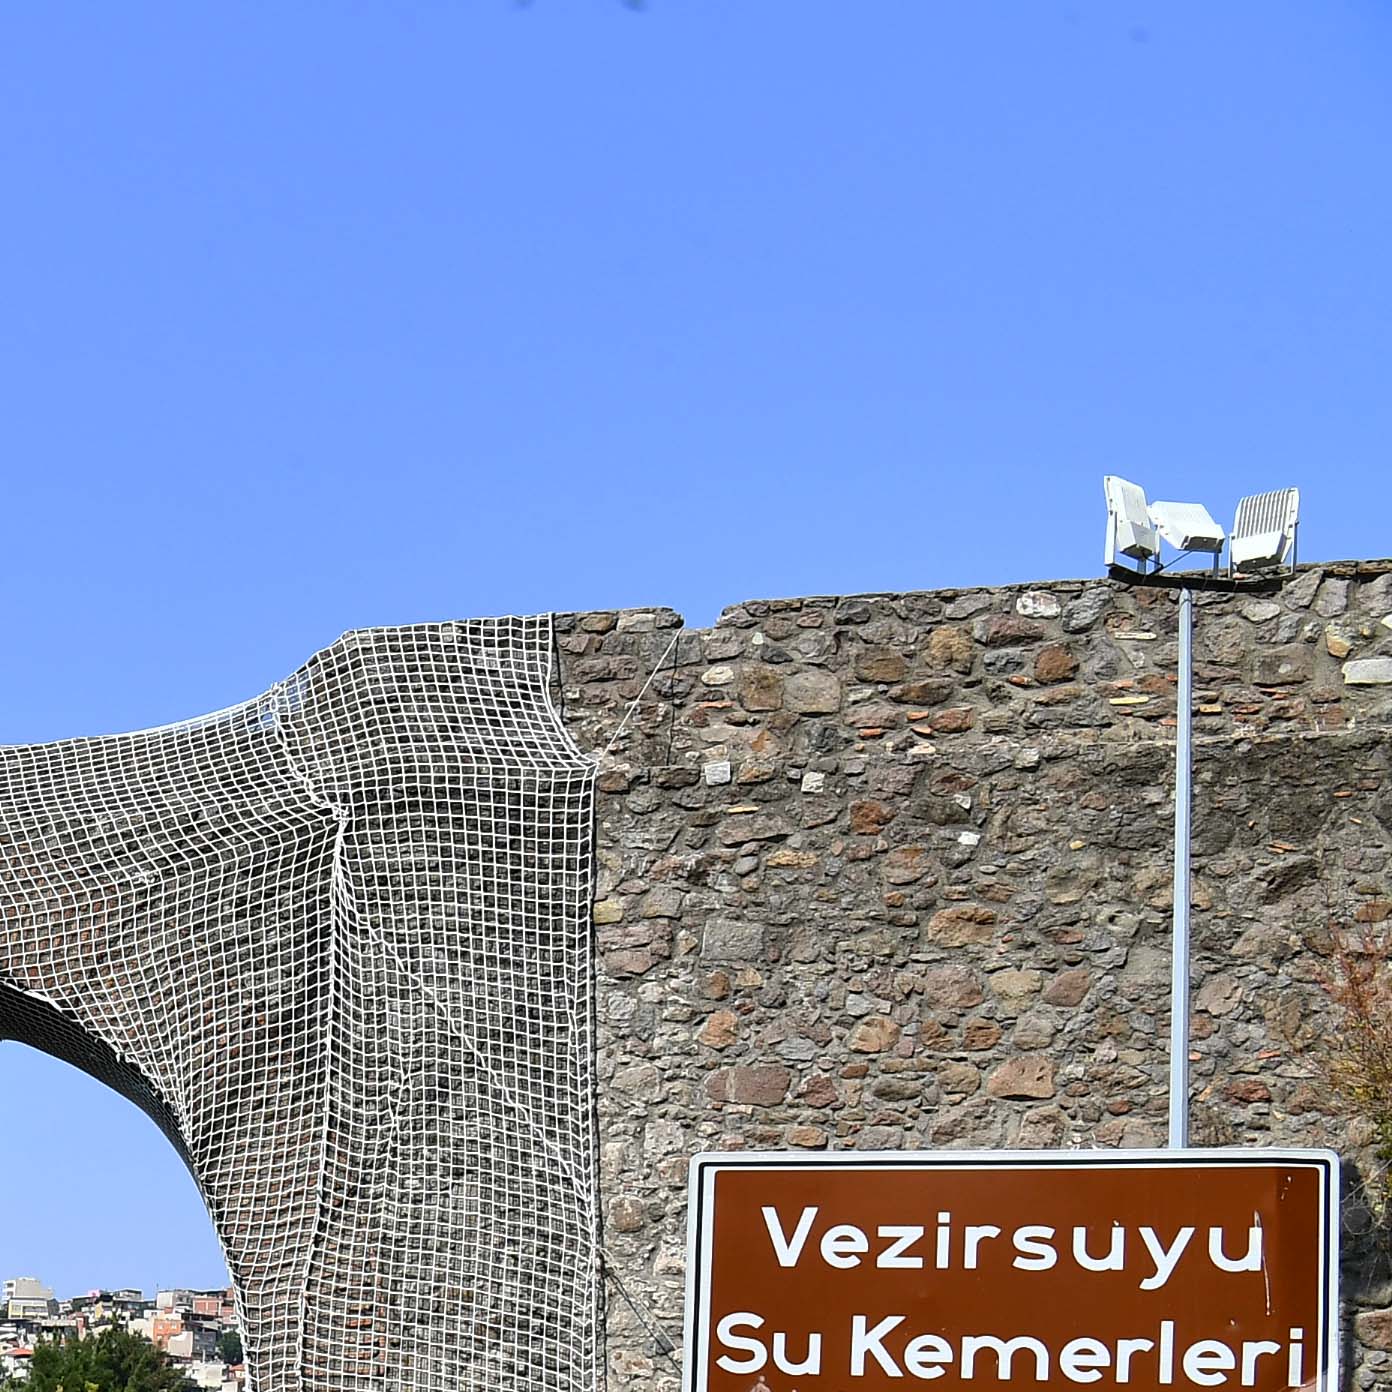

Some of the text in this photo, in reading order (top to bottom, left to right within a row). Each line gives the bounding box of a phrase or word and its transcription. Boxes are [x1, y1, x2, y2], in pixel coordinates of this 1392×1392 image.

[760, 1205, 1264, 1291] Vezirsuyu
[715, 1311, 1305, 1388] Su Kemerleri
